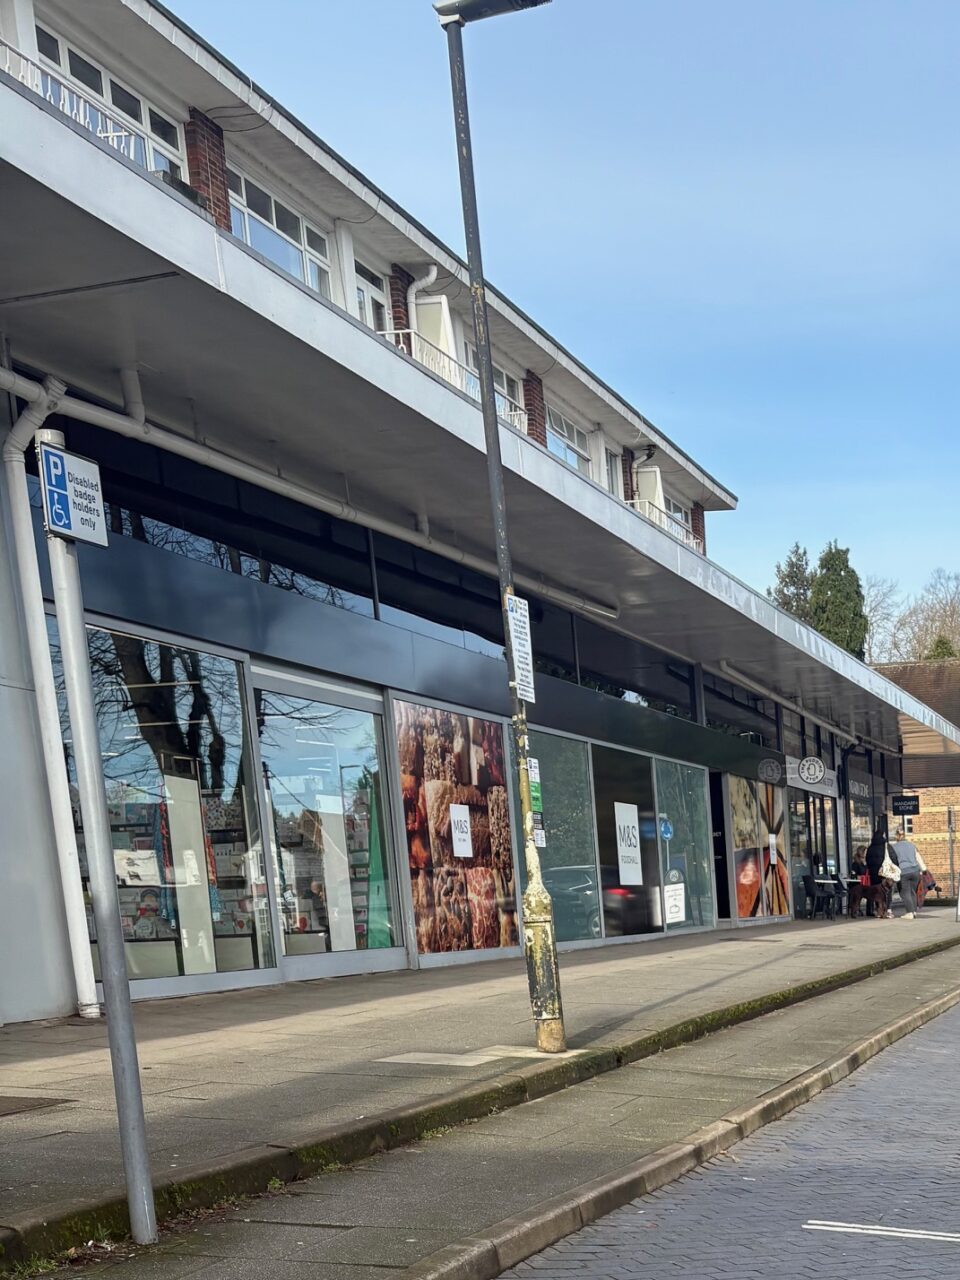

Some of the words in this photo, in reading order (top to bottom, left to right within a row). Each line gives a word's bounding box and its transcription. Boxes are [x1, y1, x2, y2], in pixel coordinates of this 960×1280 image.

[48, 454, 62, 485] P
[68, 472, 99, 492] Disabled
[74, 487, 96, 503] badge
[72, 499, 100, 517] holders
[80, 517, 96, 531] only
[453, 819, 469, 834] M&S
[618, 824, 638, 849] M&S
